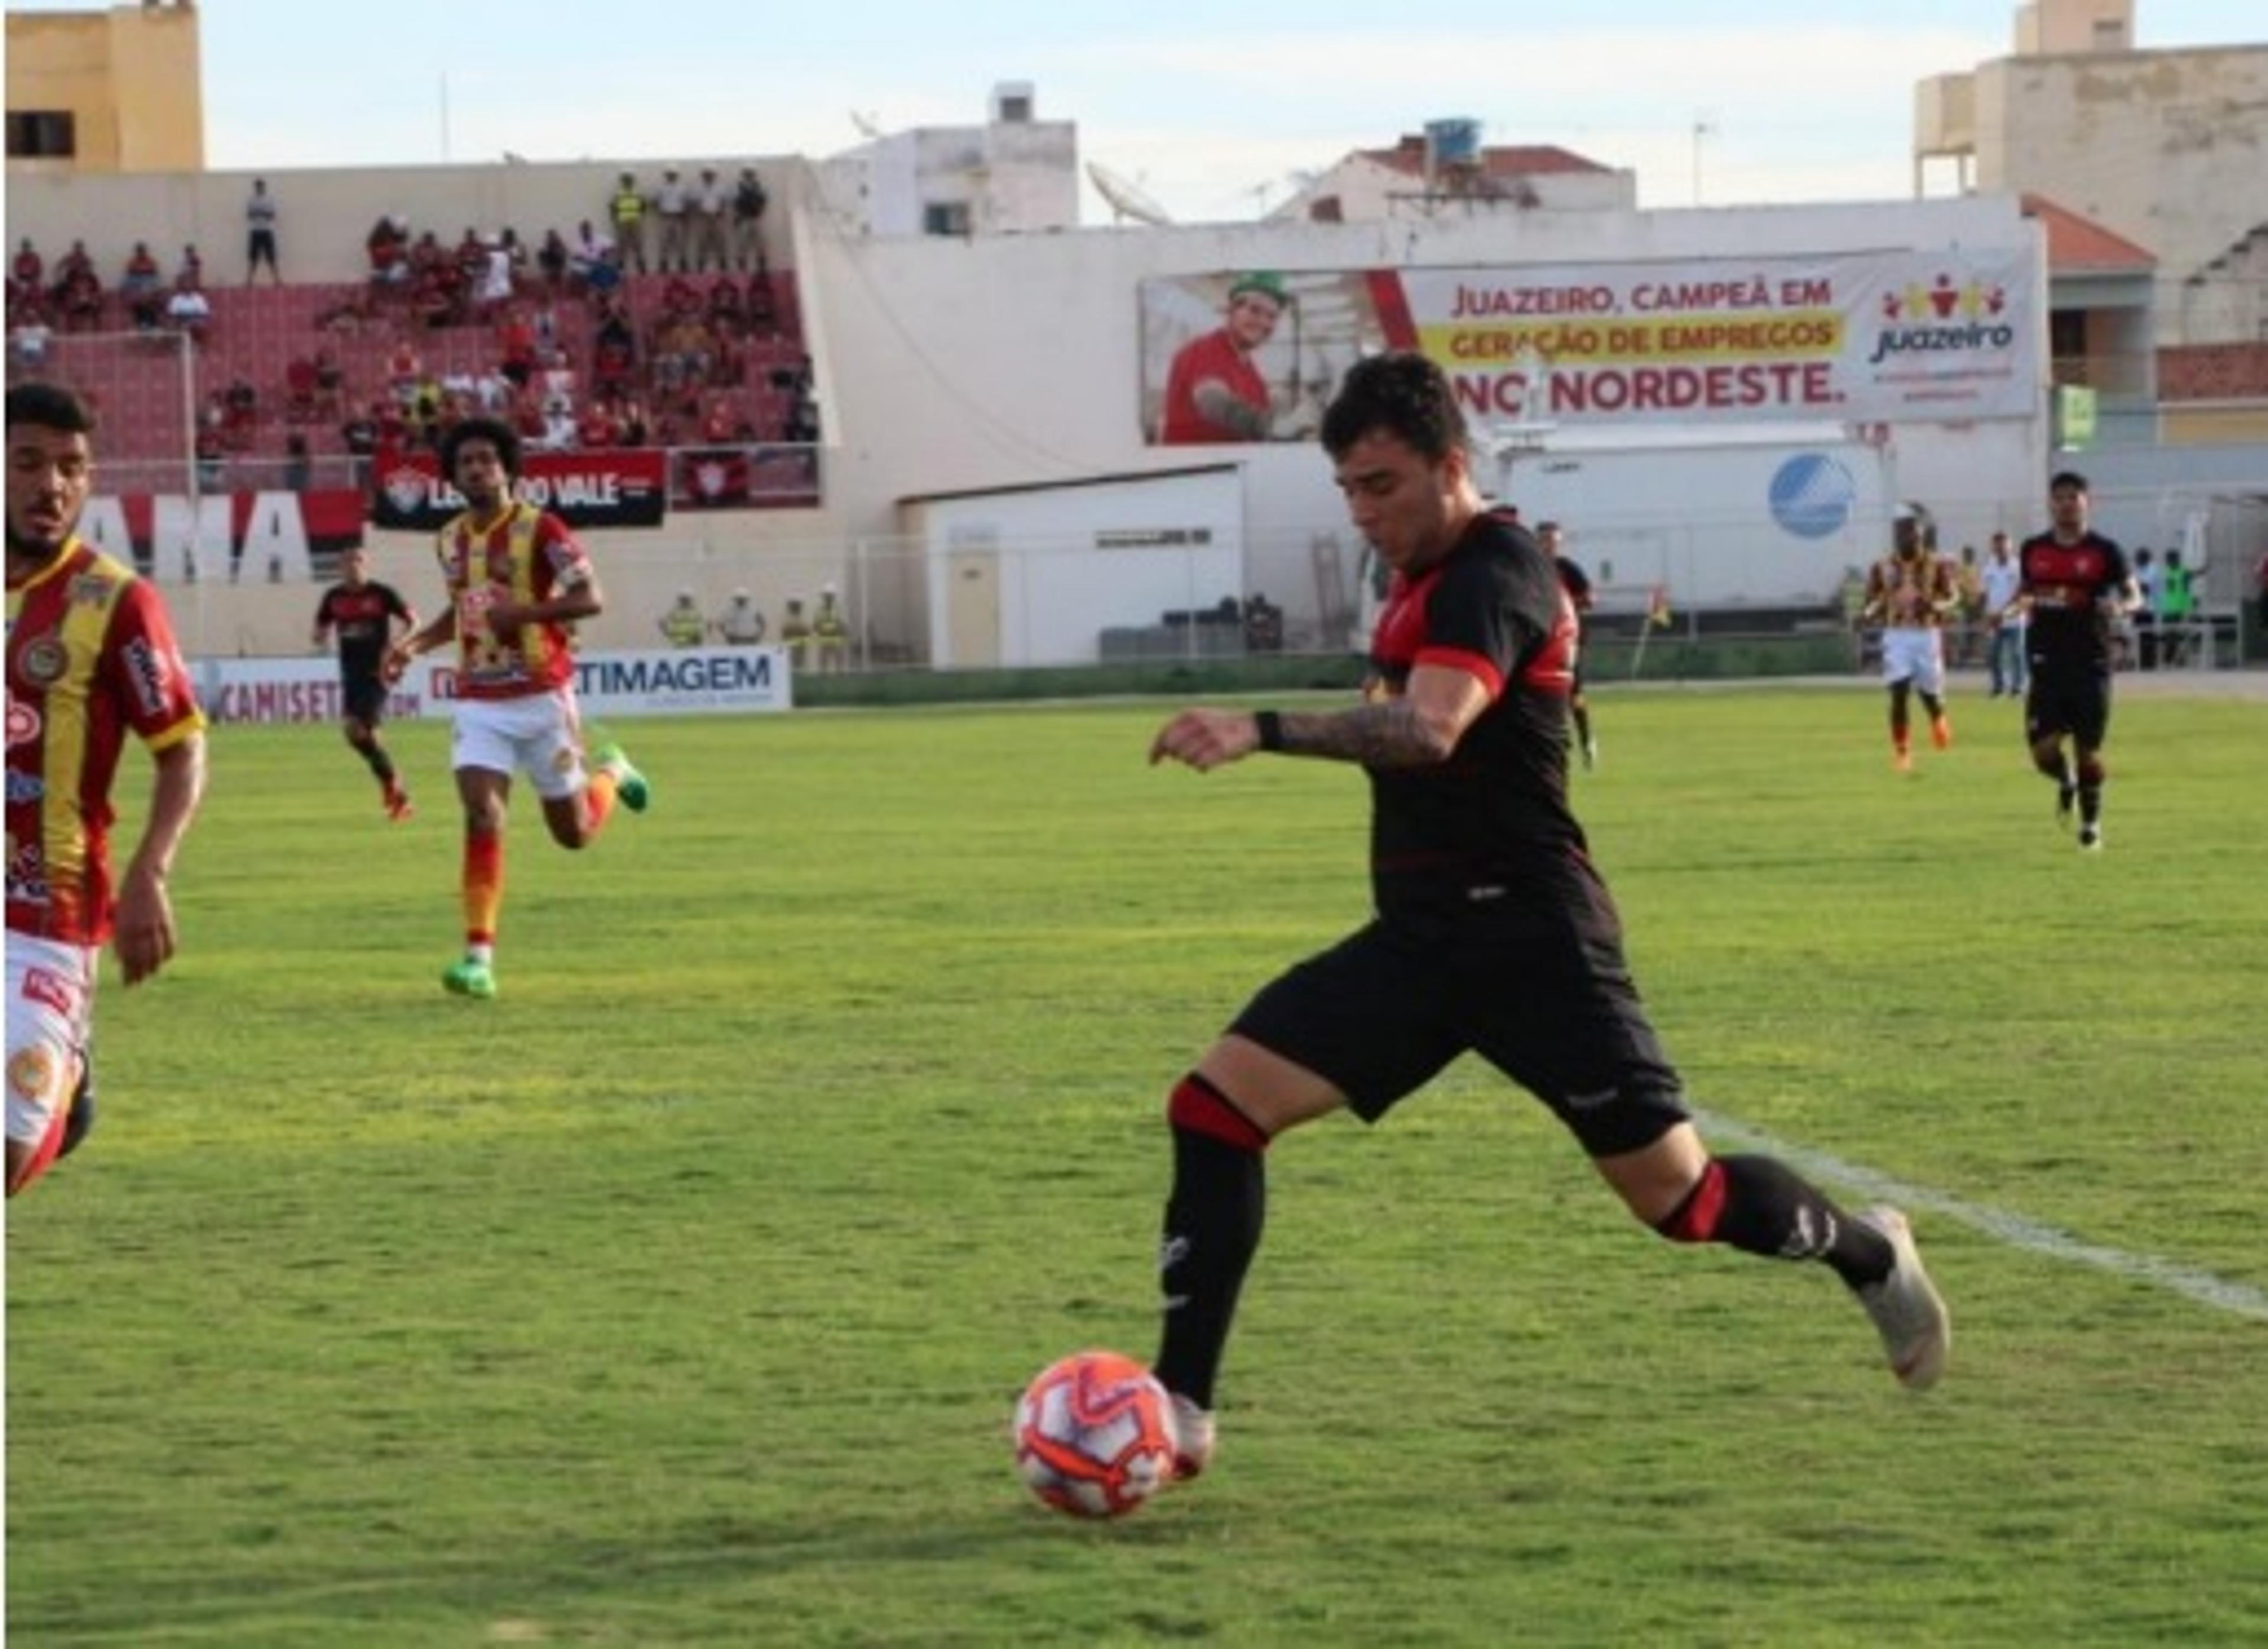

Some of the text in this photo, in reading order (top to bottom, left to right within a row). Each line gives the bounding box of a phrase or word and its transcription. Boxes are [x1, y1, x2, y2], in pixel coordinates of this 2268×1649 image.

[1450, 284, 1623, 318] JUAZEIRO,
[1781, 278, 1830, 306] EM
[1608, 327, 1650, 355] DE
[1661, 322, 1835, 352] EMPREGOS
[1550, 361, 1846, 412] NORDESTE.
[555, 472, 620, 507] VALE
[572, 654, 772, 695] TIMAGEM
